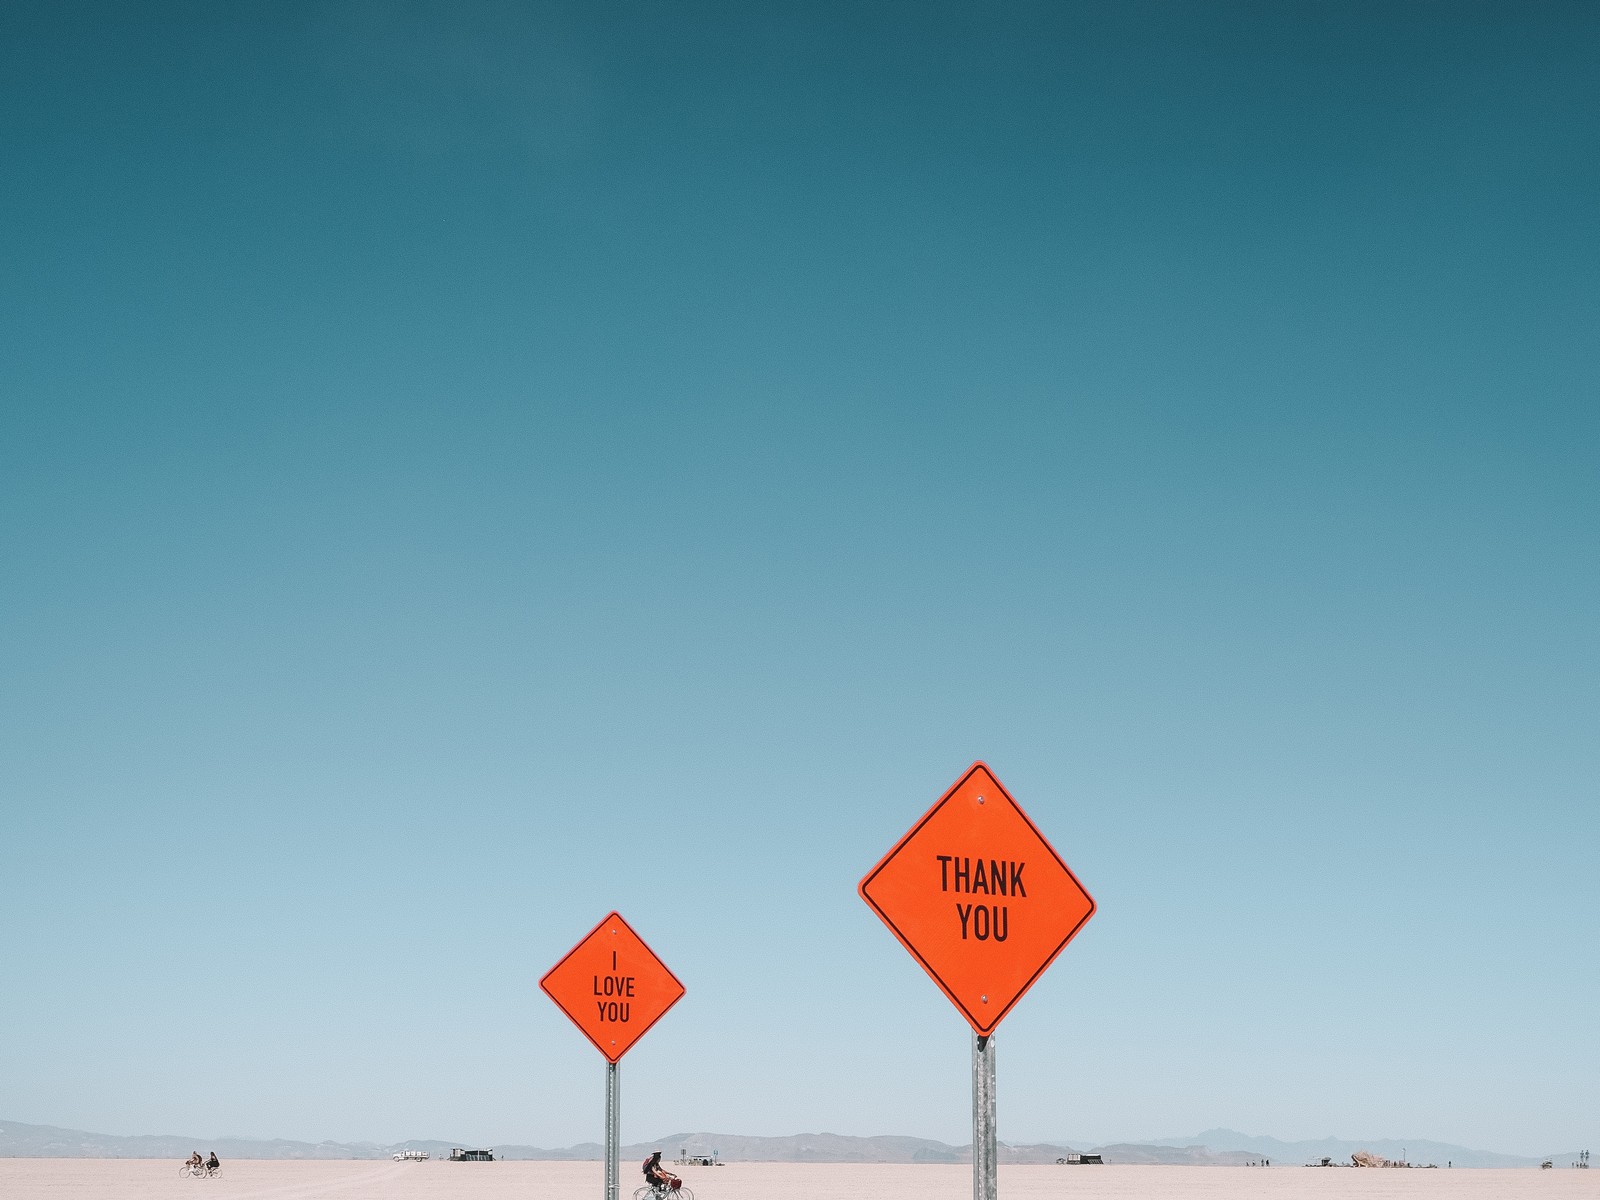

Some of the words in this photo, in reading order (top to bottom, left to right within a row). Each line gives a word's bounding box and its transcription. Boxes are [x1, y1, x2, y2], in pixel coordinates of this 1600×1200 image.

[936, 855, 1027, 897] THANK
[956, 903, 1008, 942] YOU
[612, 950, 617, 971] I
[594, 975, 635, 997] LOVE
[597, 1001, 629, 1022] YOU
